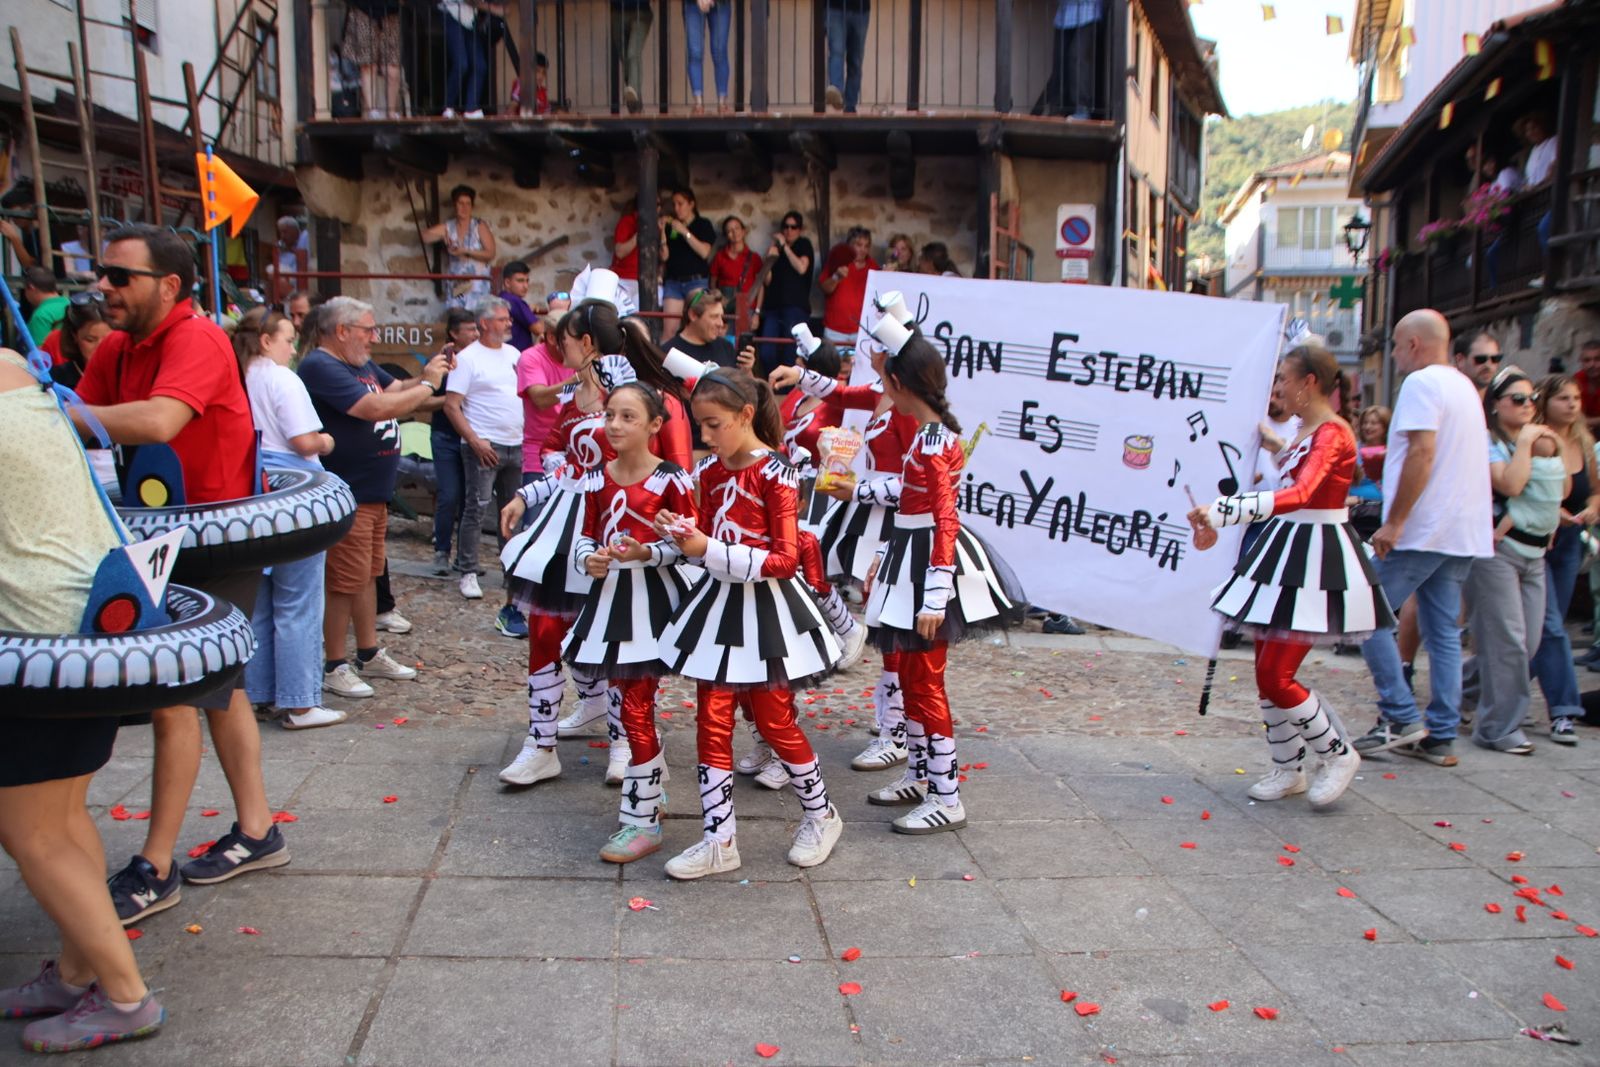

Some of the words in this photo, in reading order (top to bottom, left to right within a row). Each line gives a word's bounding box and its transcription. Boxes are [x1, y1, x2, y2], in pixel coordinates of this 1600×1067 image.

[934, 321, 1003, 379] SAN
[1046, 331, 1203, 400] ESTEBAN
[1020, 400, 1063, 454] ES
[148, 543, 170, 580] 19
